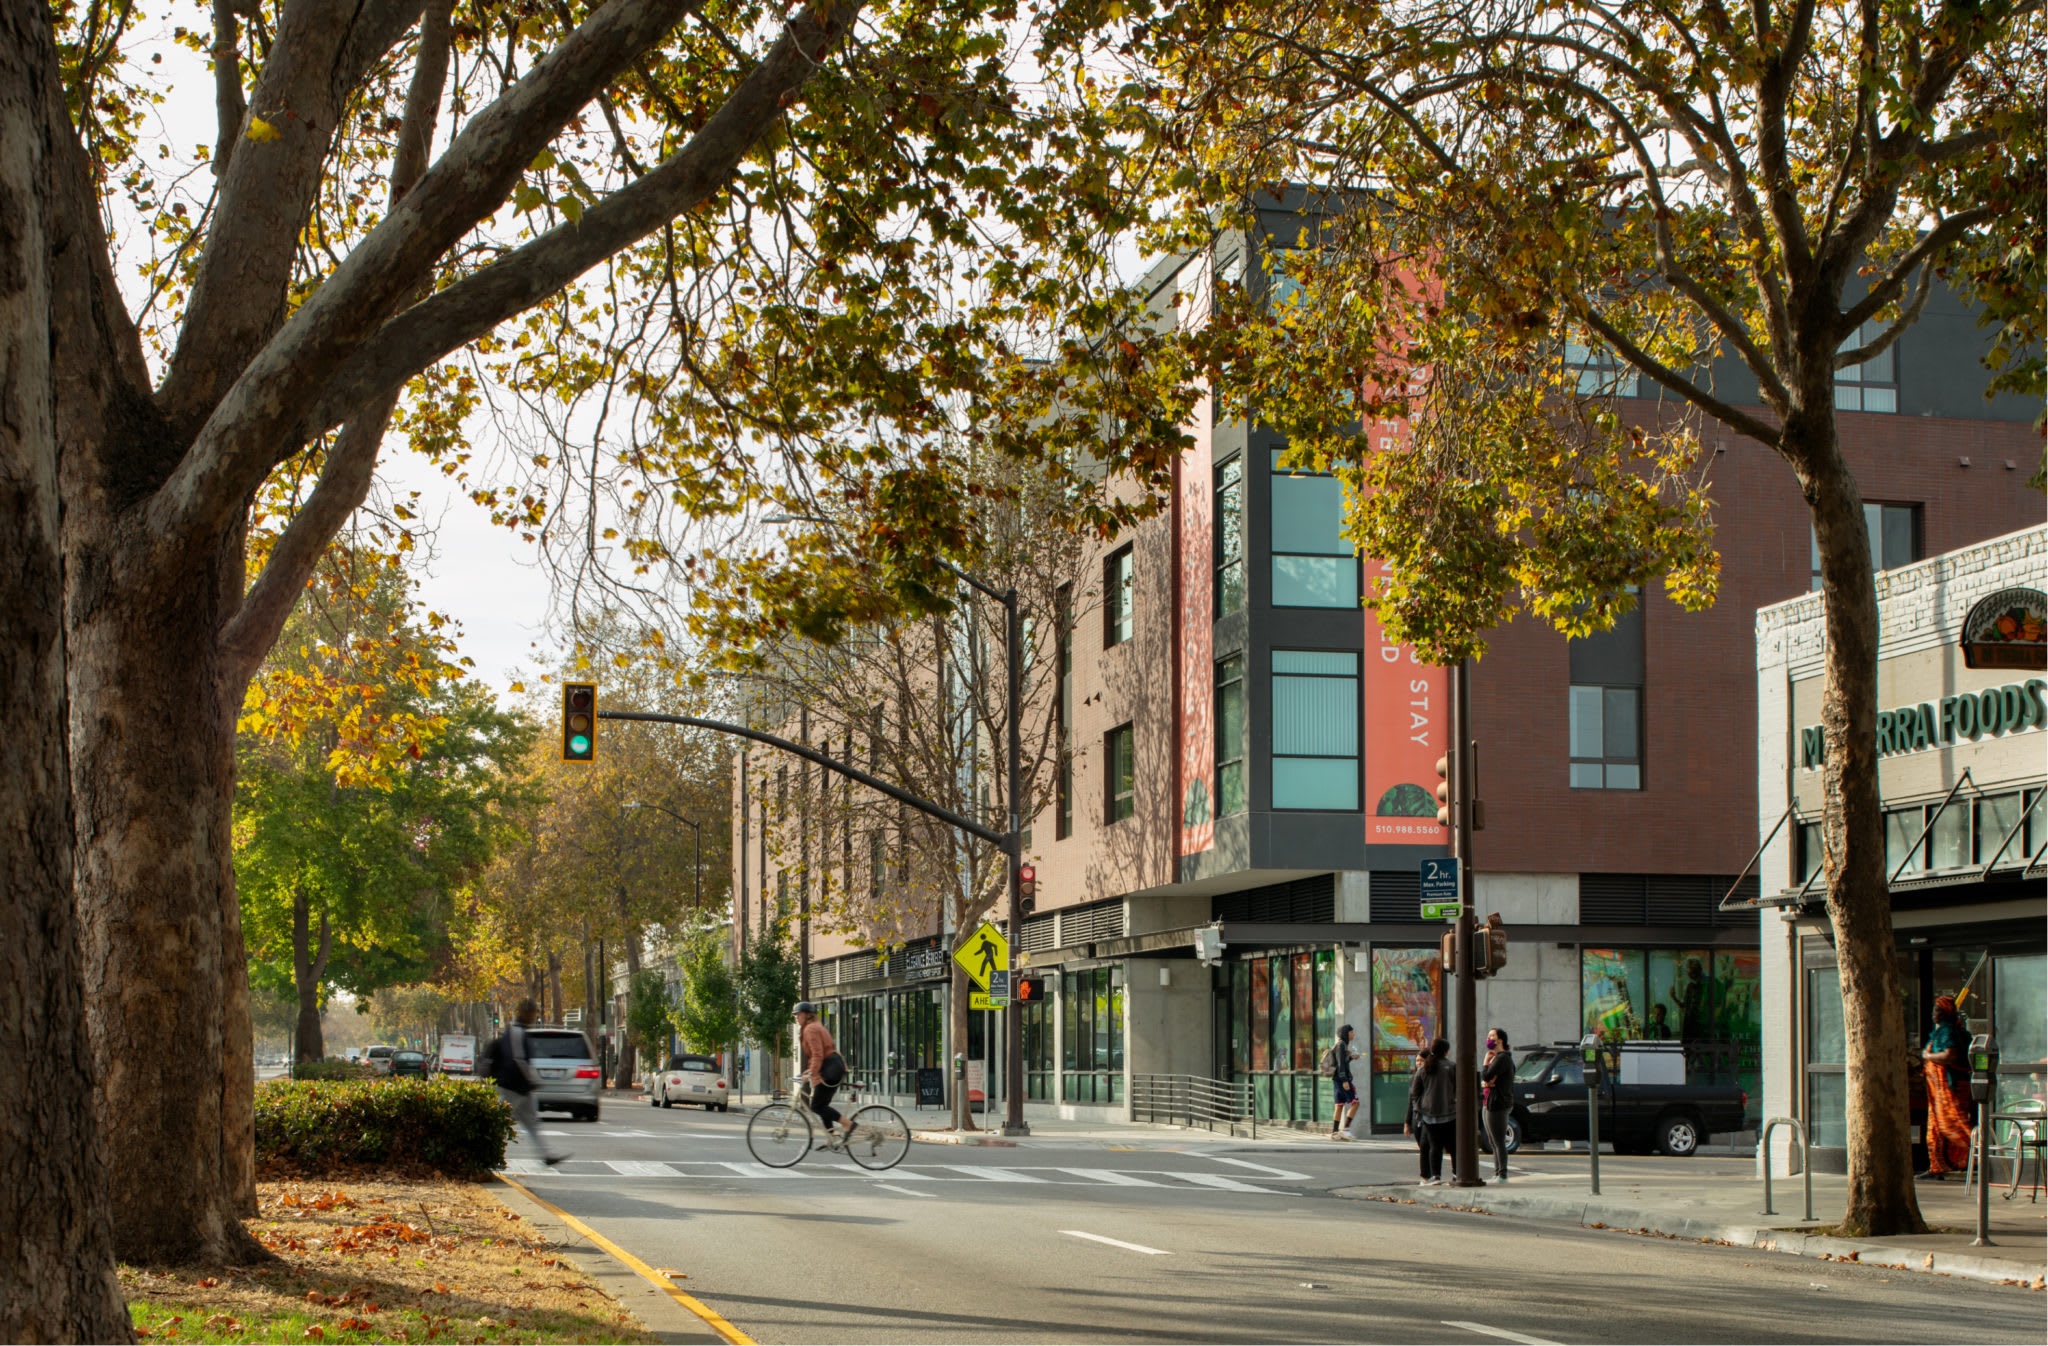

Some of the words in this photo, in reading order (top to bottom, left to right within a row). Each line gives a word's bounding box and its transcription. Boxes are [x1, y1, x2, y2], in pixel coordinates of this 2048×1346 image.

[1410, 679, 1429, 747] STAY
[1939, 679, 2047, 742] FOODS
[1375, 825, 1440, 834] 510.988.5560
[1428, 862, 1438, 879] 2
[1439, 870, 1451, 879] hr.
[992, 972, 999, 983] 2
